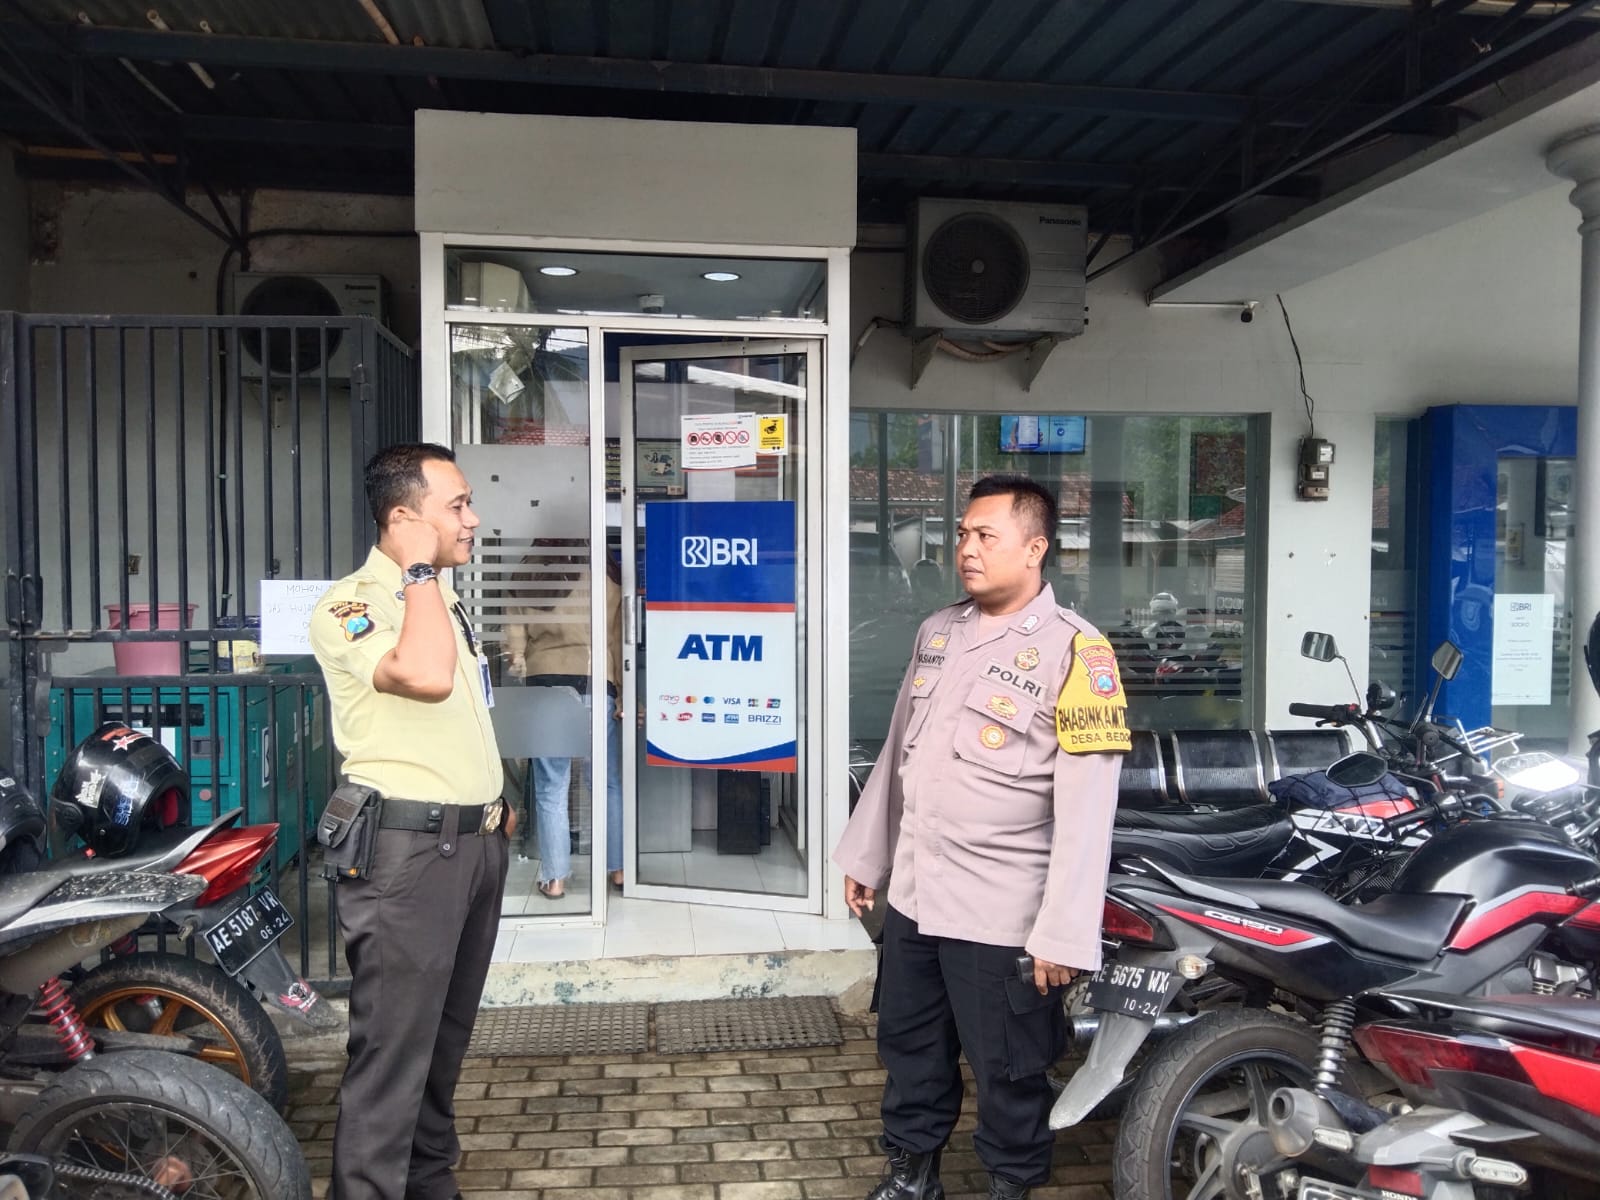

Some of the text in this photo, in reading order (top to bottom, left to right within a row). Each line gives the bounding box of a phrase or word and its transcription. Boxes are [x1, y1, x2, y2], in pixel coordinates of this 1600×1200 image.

[712, 538, 758, 566] BRI
[677, 634, 763, 662] ATM
[986, 664, 1043, 698] POLRI
[722, 697, 742, 705] VISA
[747, 714, 782, 725] BRIZZI
[1070, 732, 1102, 745] DESA
[211, 926, 233, 954] AE
[228, 904, 260, 937] 5187
[257, 890, 279, 912] VR
[1110, 964, 1146, 990] 5675
[1147, 970, 1171, 994] WX
